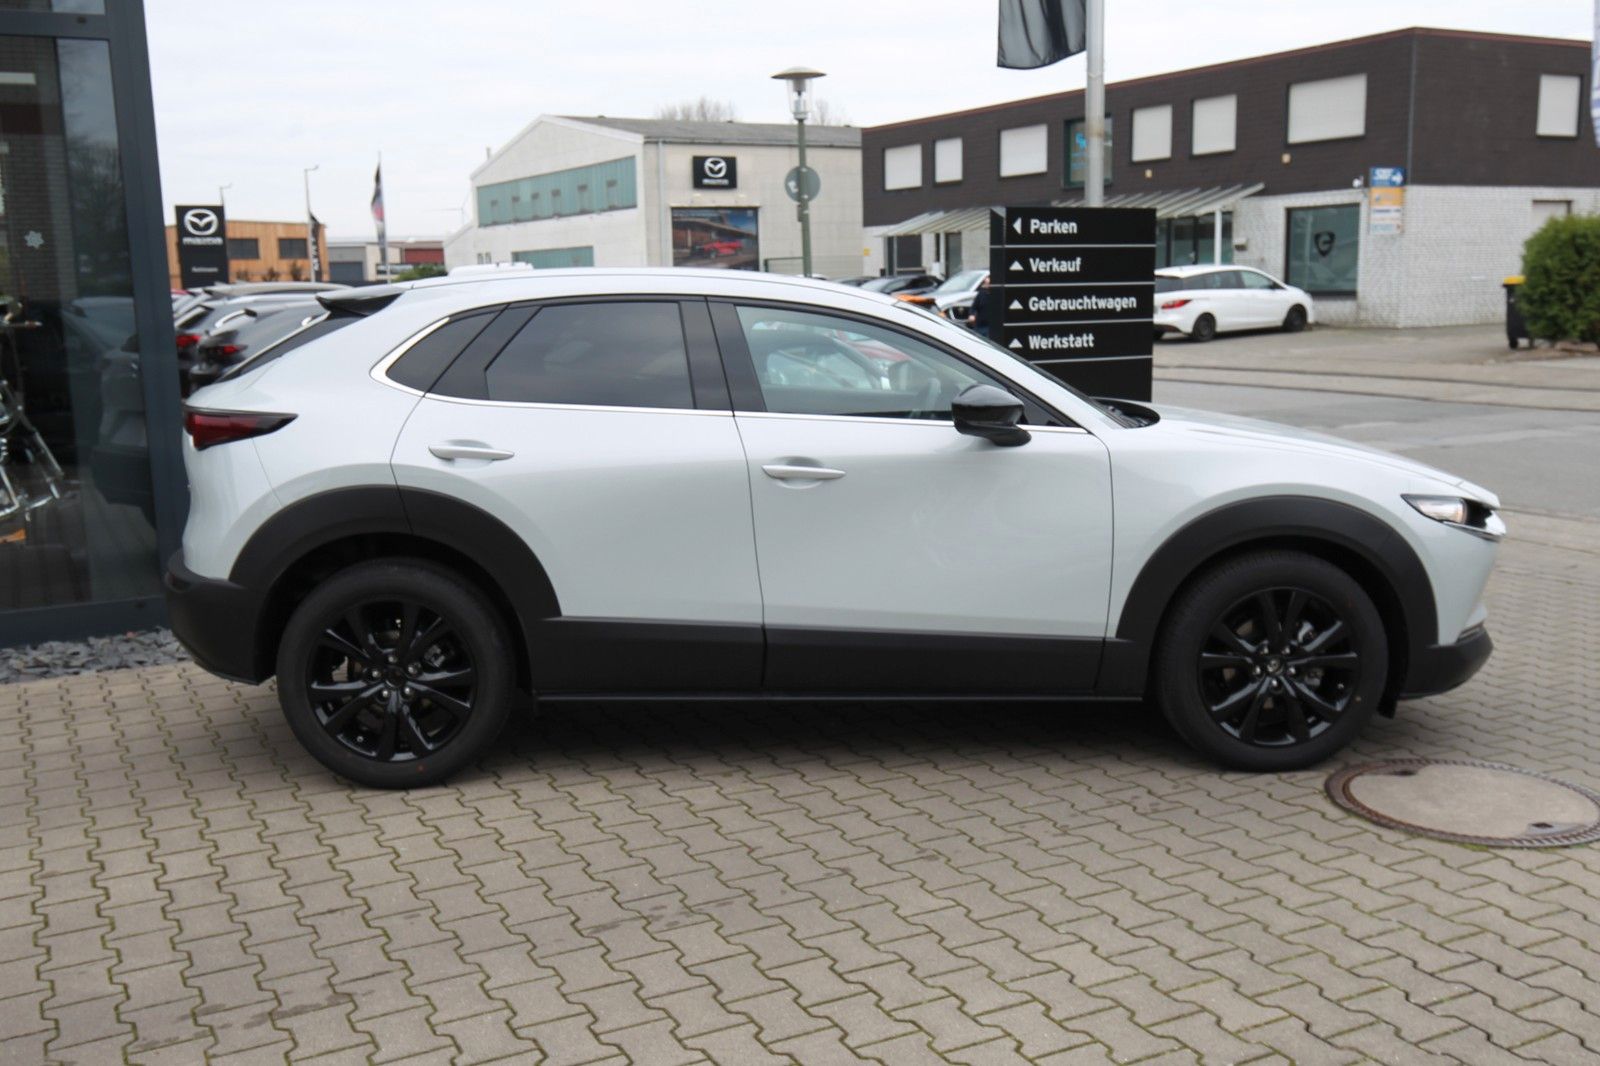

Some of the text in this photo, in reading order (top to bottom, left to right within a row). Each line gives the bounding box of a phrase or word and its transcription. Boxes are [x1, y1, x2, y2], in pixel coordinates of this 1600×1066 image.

[1030, 218, 1078, 234] Parken
[1029, 256, 1082, 273] Verkauf
[1028, 295, 1137, 312] Gebrauchtwagen
[1028, 333, 1095, 350] Werkstatt
